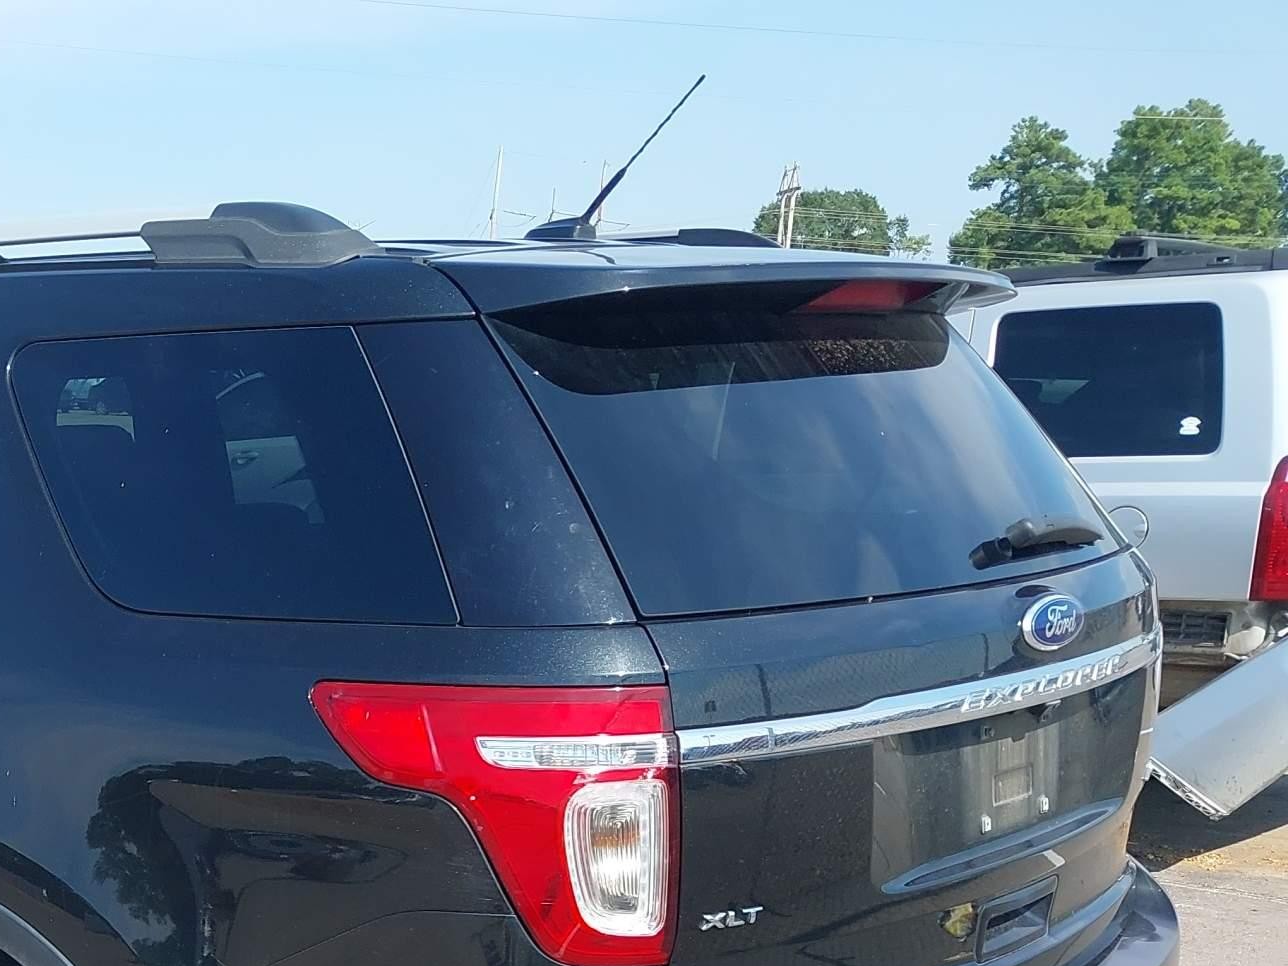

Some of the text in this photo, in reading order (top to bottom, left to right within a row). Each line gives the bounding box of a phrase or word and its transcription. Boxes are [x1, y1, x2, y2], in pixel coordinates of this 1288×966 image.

[1045, 604, 1078, 639] Ford
[961, 654, 1125, 714] EXPLORER
[699, 906, 764, 931] XLT
